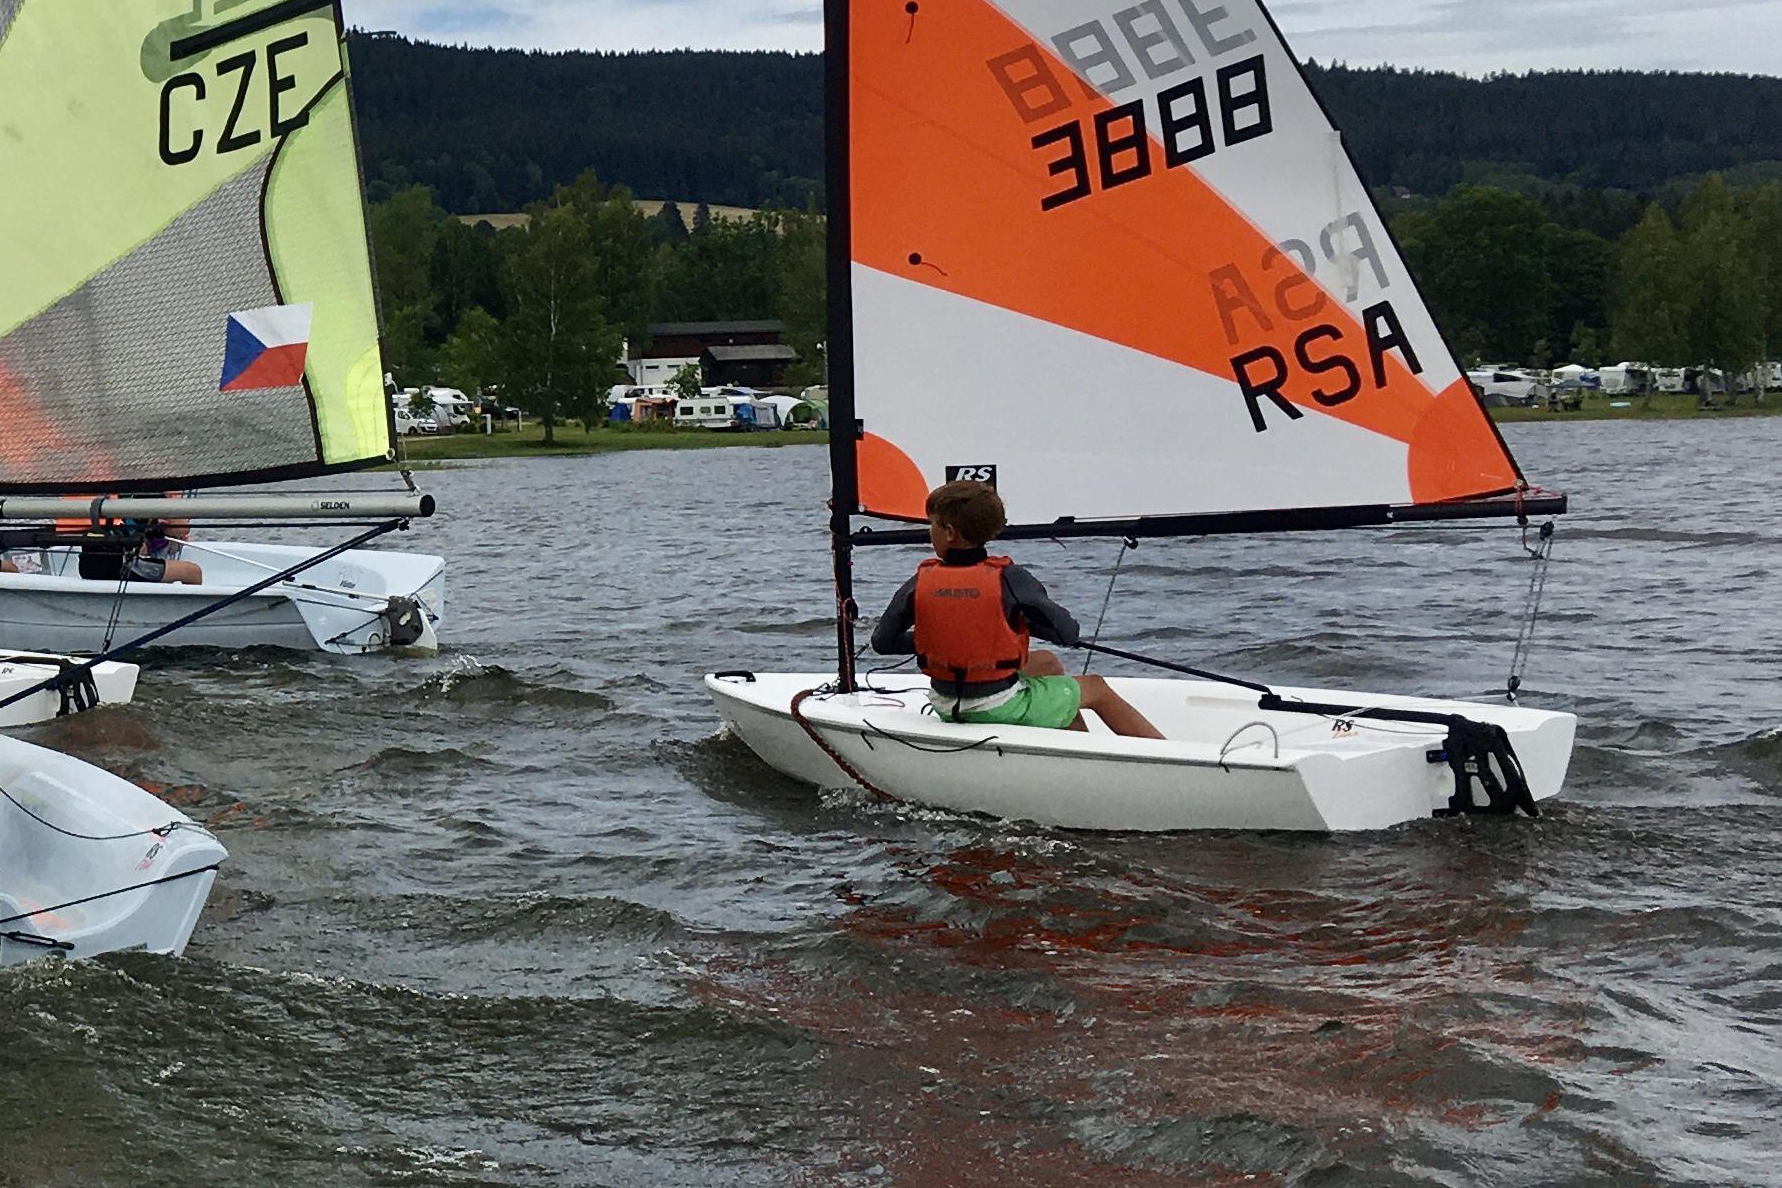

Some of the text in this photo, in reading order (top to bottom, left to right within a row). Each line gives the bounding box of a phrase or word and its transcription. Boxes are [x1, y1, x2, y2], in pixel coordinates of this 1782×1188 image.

[159, 31, 310, 165] CZE
[1032, 54, 1273, 211] 3888
[1230, 300, 1423, 432] RSA
[955, 466, 993, 482] RS
